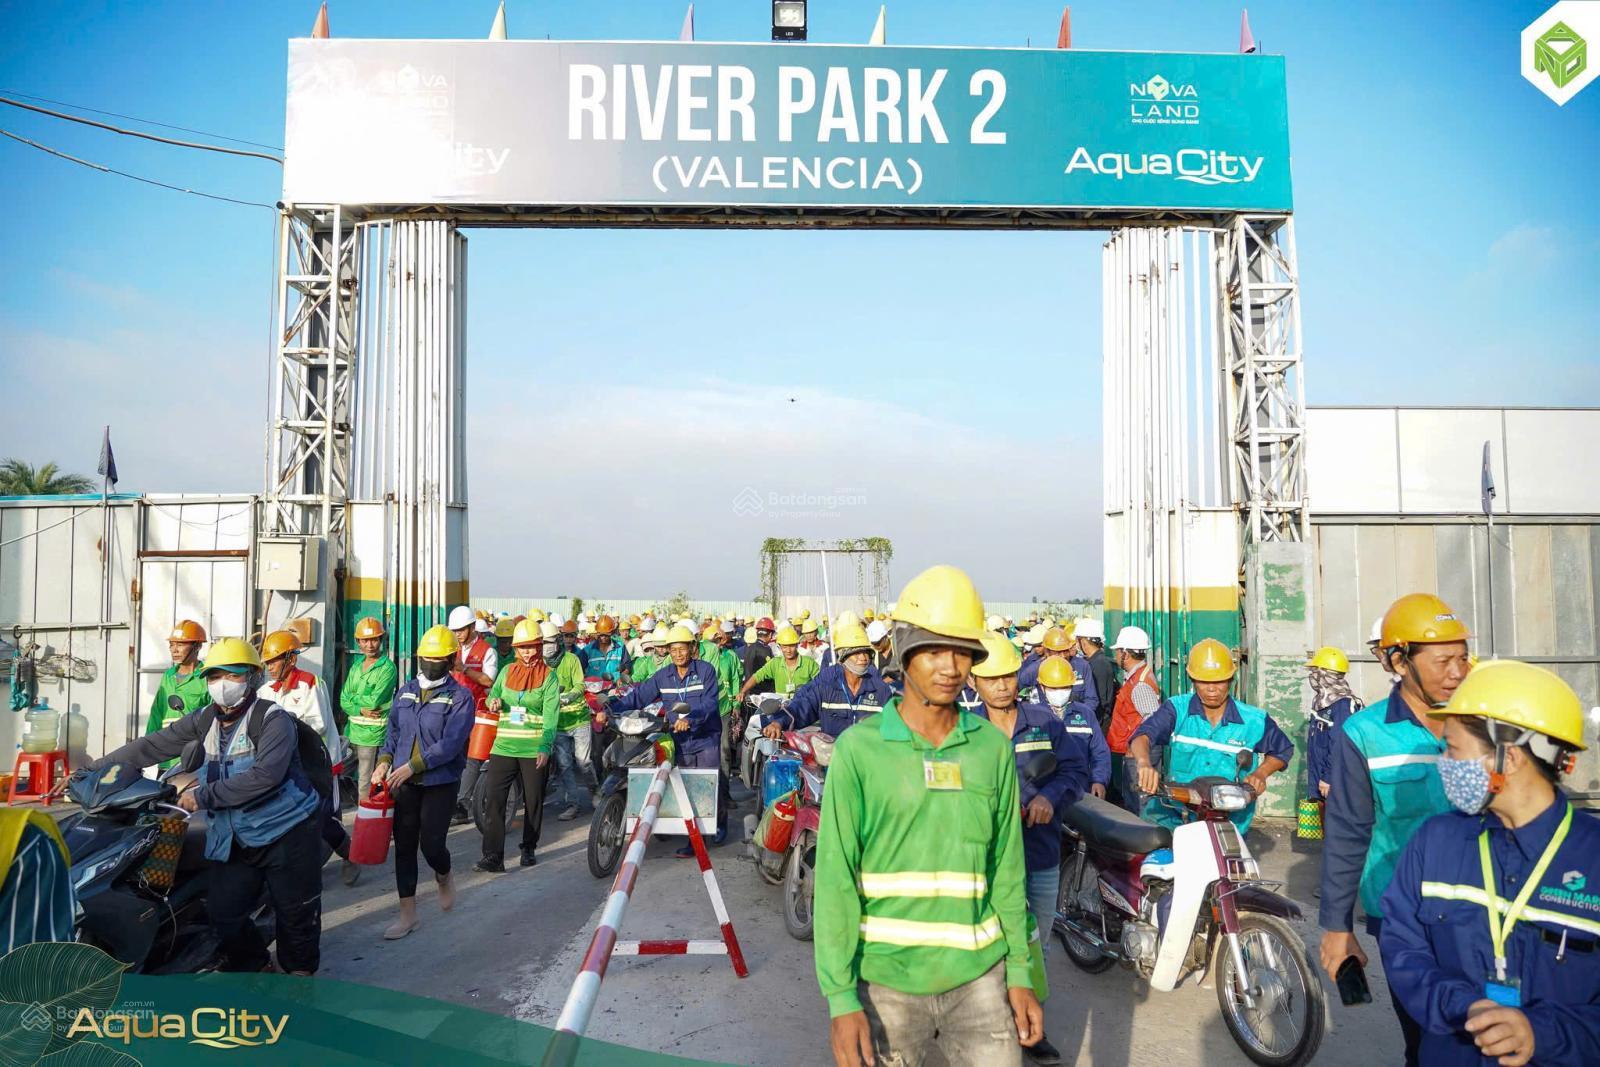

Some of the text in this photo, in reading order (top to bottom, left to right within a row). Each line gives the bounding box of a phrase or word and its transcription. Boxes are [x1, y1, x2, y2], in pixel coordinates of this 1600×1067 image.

[567, 63, 1007, 145] RIVER PARK 2
[1131, 103, 1199, 118] LAND
[652, 155, 924, 194] (VALENCIA)
